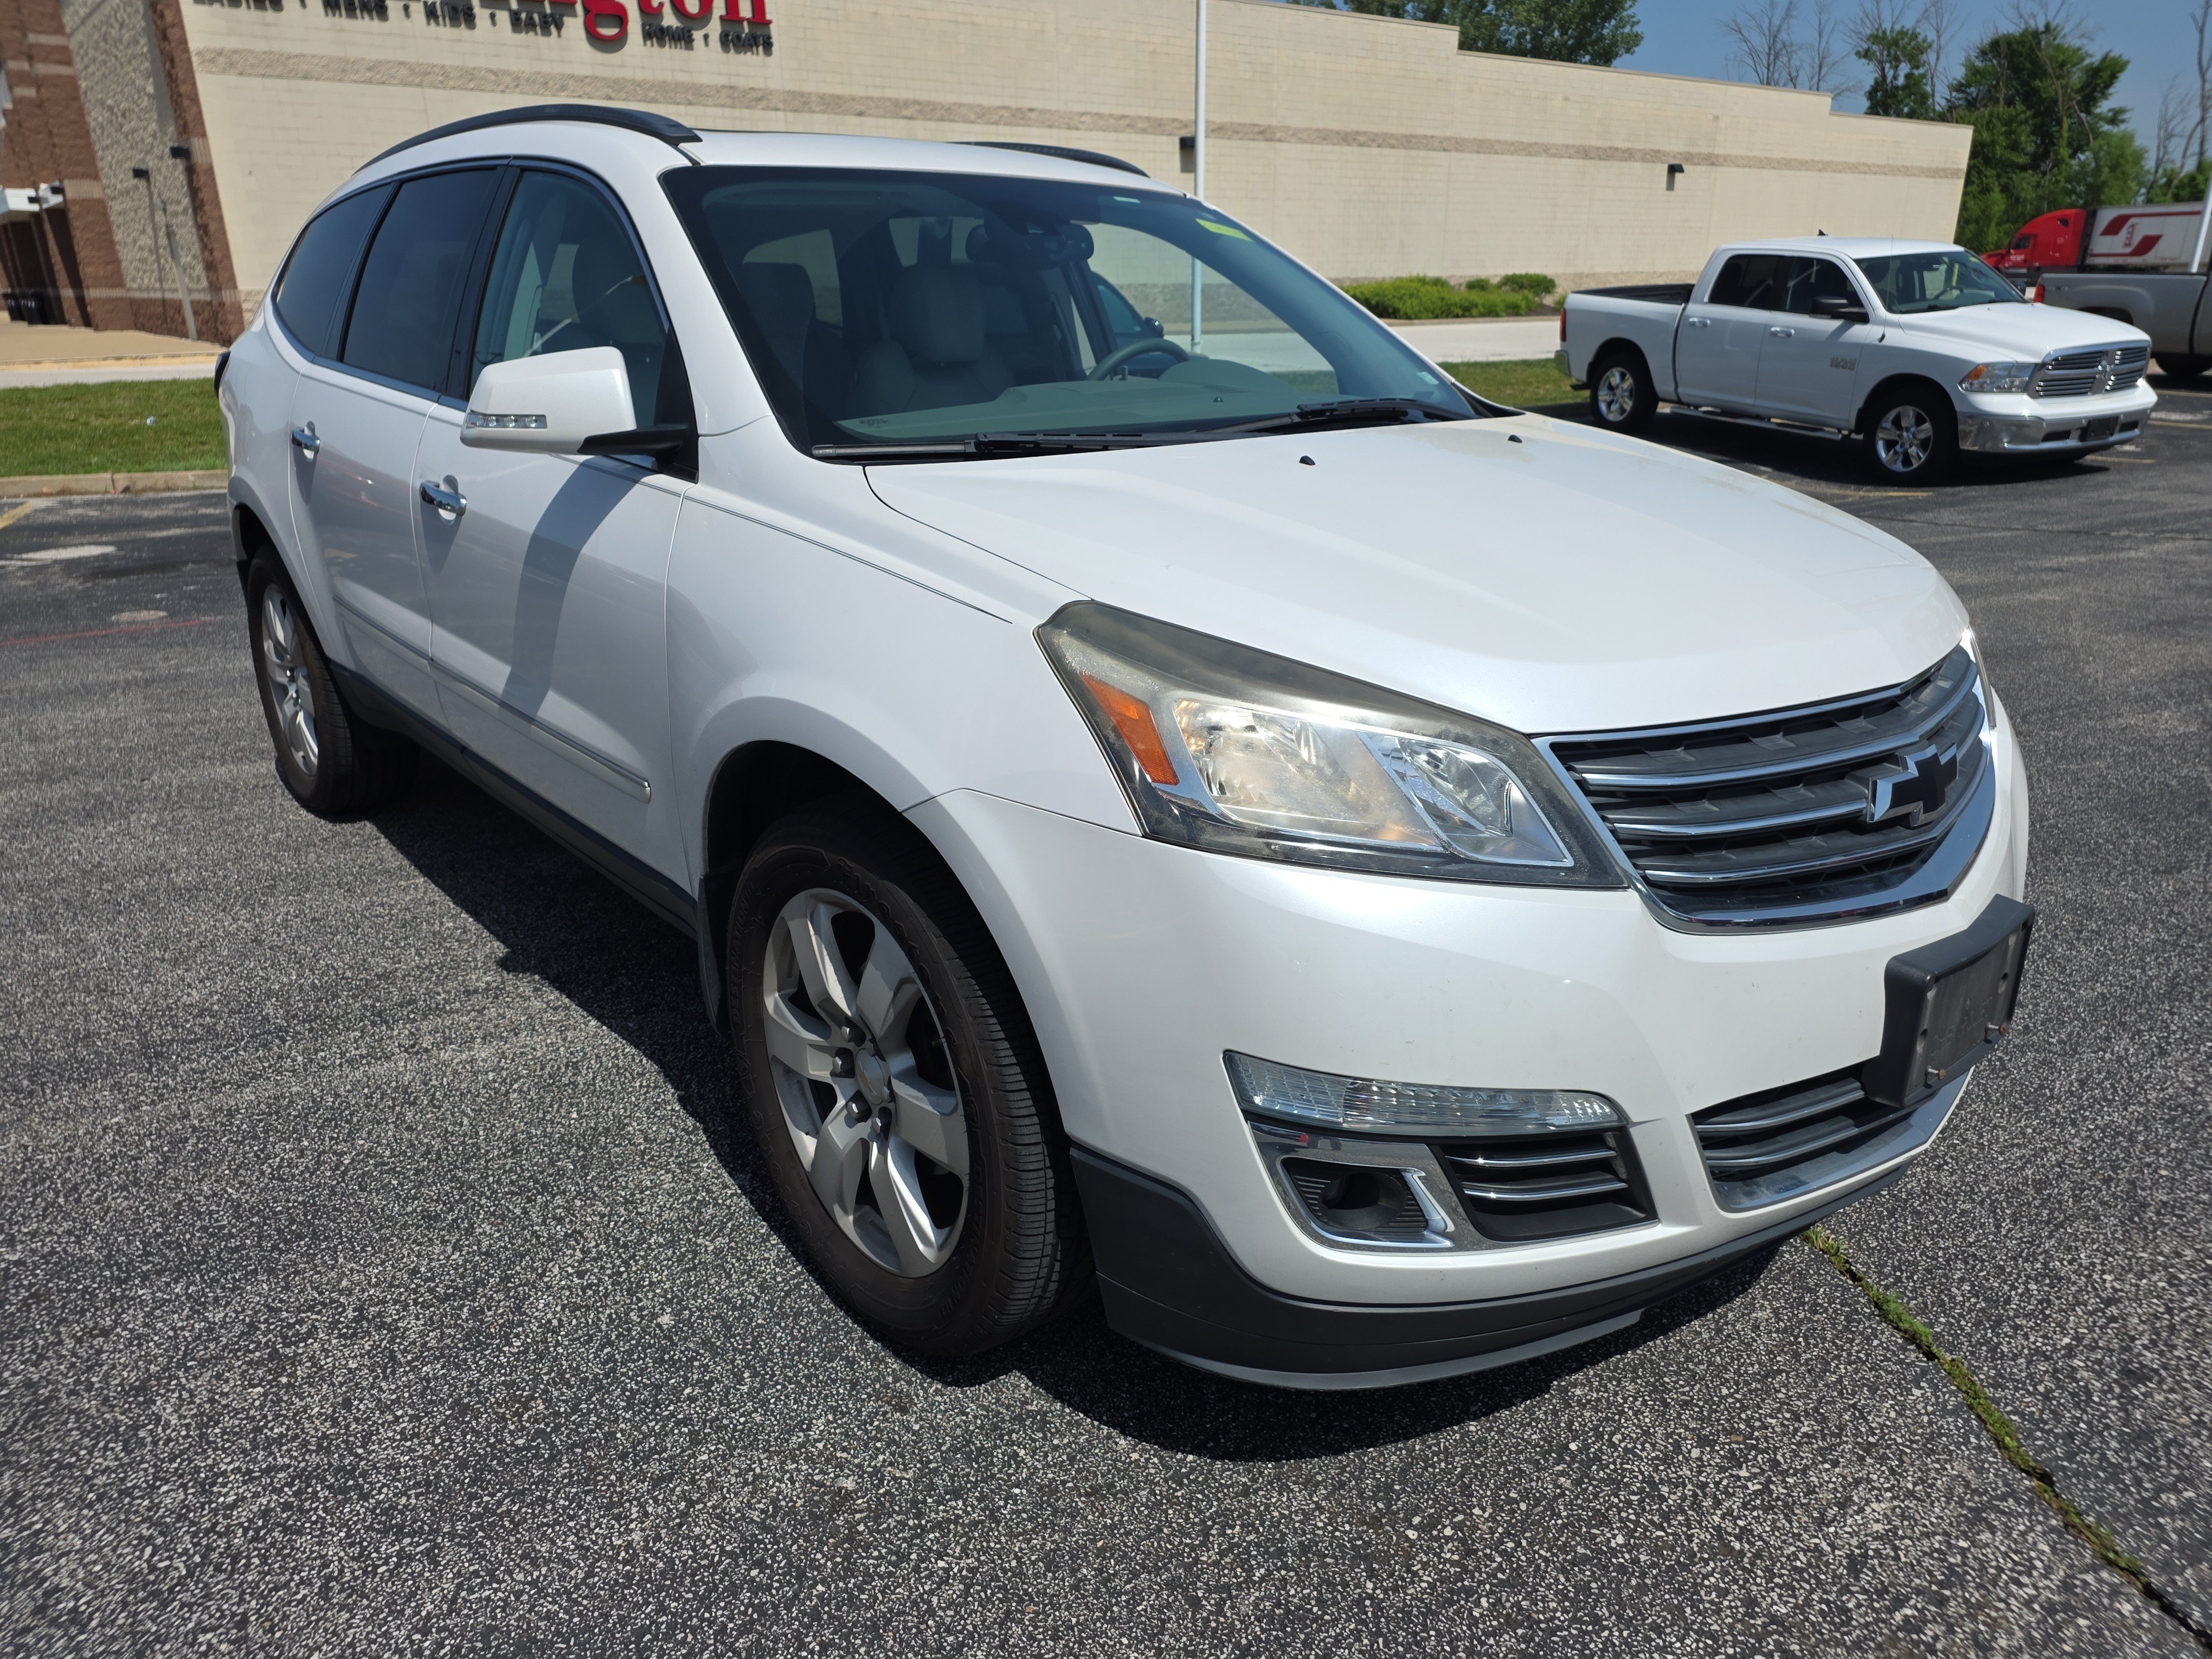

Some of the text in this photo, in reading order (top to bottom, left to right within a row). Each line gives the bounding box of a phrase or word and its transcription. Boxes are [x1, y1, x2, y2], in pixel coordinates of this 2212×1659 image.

[322, 0, 773, 50] MENS KIDS BABY HOME COATS
[729, 897, 751, 1025] DESTINATION
[951, 1163, 984, 1302] DESTINATION
